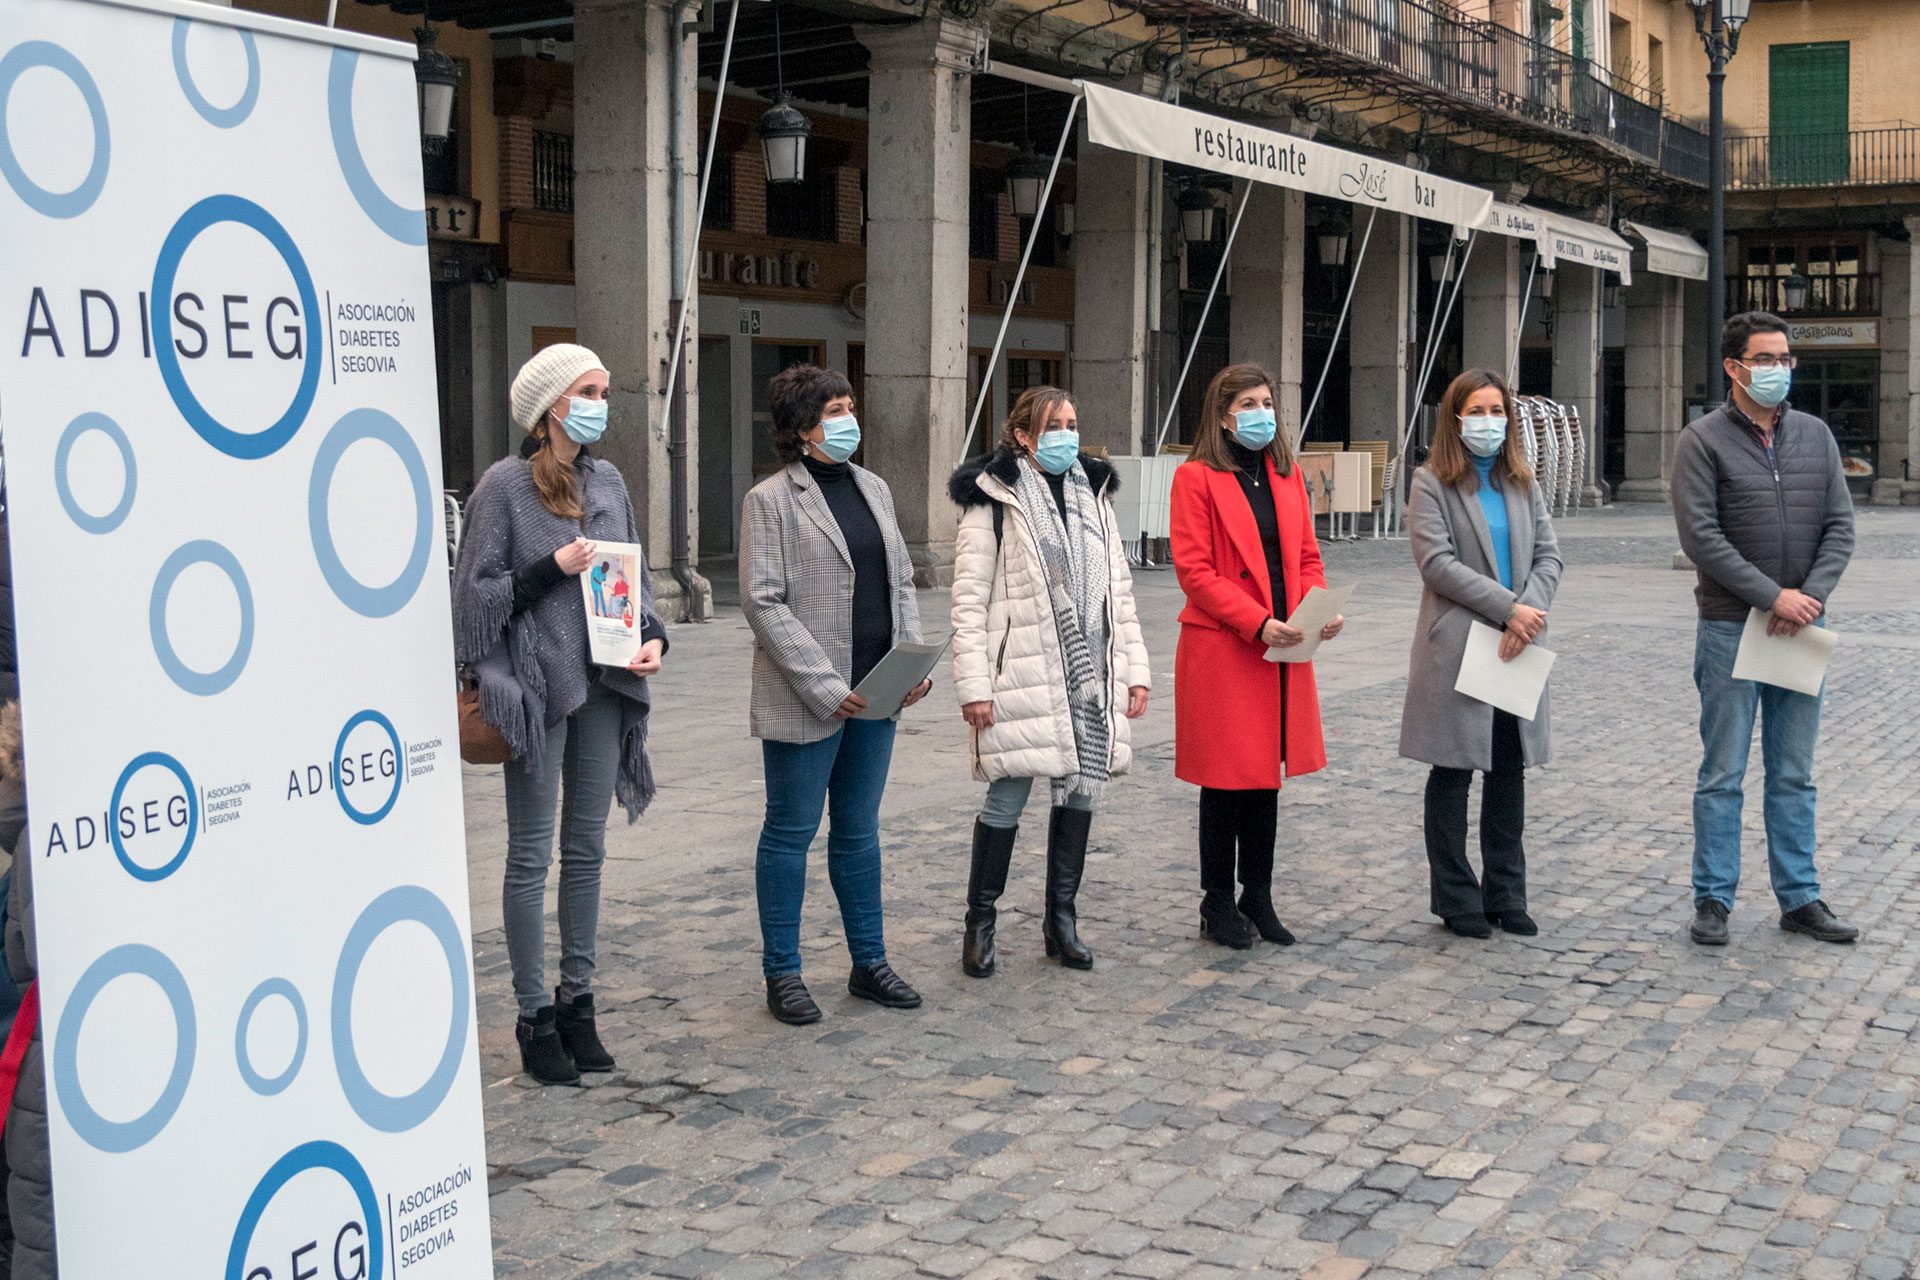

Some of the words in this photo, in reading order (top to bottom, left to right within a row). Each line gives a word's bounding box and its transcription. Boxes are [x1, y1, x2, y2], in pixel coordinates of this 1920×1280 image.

[1194, 126, 1307, 177] restaurante
[1339, 163, 1387, 202] José
[1415, 175, 1436, 208] bar
[21, 287, 303, 360] ADISEG
[338, 298, 415, 322] ASOCIACIÓN
[339, 329, 400, 347] DIABETES
[341, 355, 397, 373] SEGOVIA
[409, 737, 442, 753] ASOCIACIÓN
[410, 752, 436, 765] DIABETES
[287, 748, 396, 801] ADISEG
[410, 765, 434, 777] SEGOVIA
[207, 780, 251, 799] ASOCIACIÓN
[207, 797, 243, 813] DIABETES
[208, 811, 240, 826] SEGOVIA
[46, 795, 189, 858] ADISEG
[398, 1163, 472, 1217] ASOCIACIÓN
[400, 1200, 458, 1242] DIABETES
[401, 1228, 455, 1268] SEGOVIA
